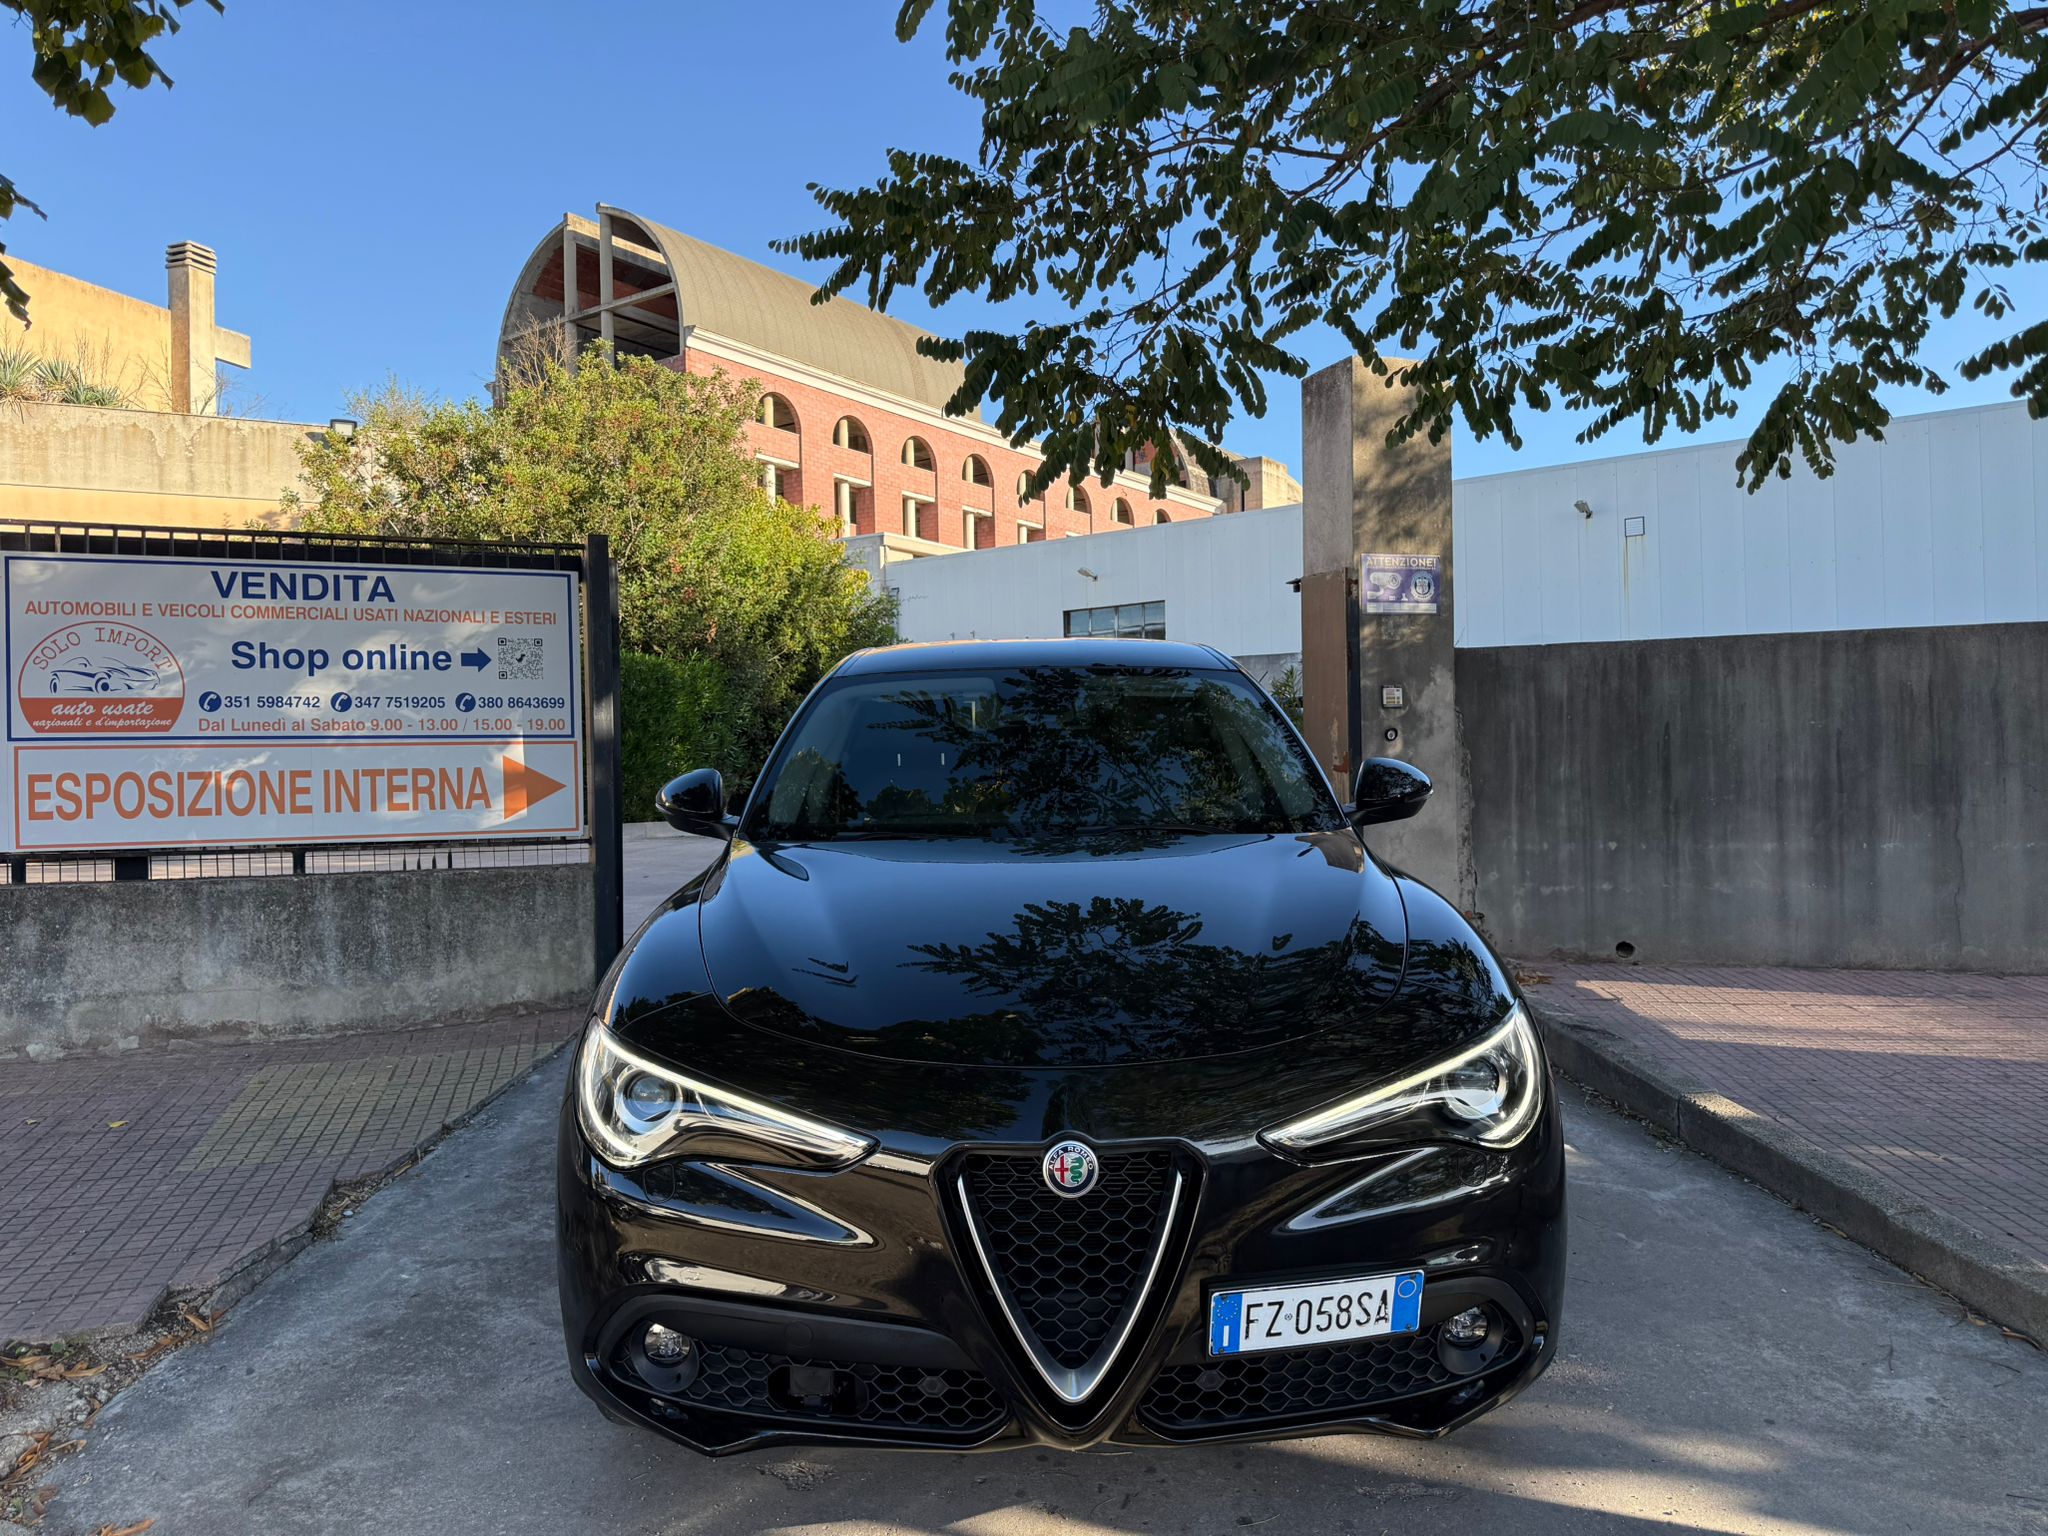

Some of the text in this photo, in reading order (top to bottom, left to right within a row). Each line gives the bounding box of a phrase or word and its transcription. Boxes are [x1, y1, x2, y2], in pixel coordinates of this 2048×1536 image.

[1366, 556, 1436, 567] ATTENZIONE!
[211, 570, 396, 603] VENDITA
[25, 600, 557, 625] AUTOMOBILI E VEICOLI COMMERCIALI USATI NAZIONALI E ESTERI
[33, 627, 173, 671] SOLO IMPORT
[231, 640, 452, 677] Shop online
[51, 701, 155, 715] auto usate
[224, 696, 321, 709] 351 5984742
[354, 696, 446, 709] 347 7519205
[478, 697, 566, 709] 380 8643699
[32, 716, 173, 730] nazionali e d'importazione
[199, 718, 225, 732] Dal
[231, 717, 286, 732] Lunedì
[291, 718, 305, 731] al
[311, 718, 366, 732] Sabato
[370, 718, 403, 731] 9.00
[418, 718, 458, 731] 13.00
[473, 718, 513, 731] 15.00
[527, 718, 566, 731] 19.00
[27, 766, 493, 821] ESPOSIZIONE INTERNA
[1049, 1146, 1094, 1170] ALFA ROMEO
